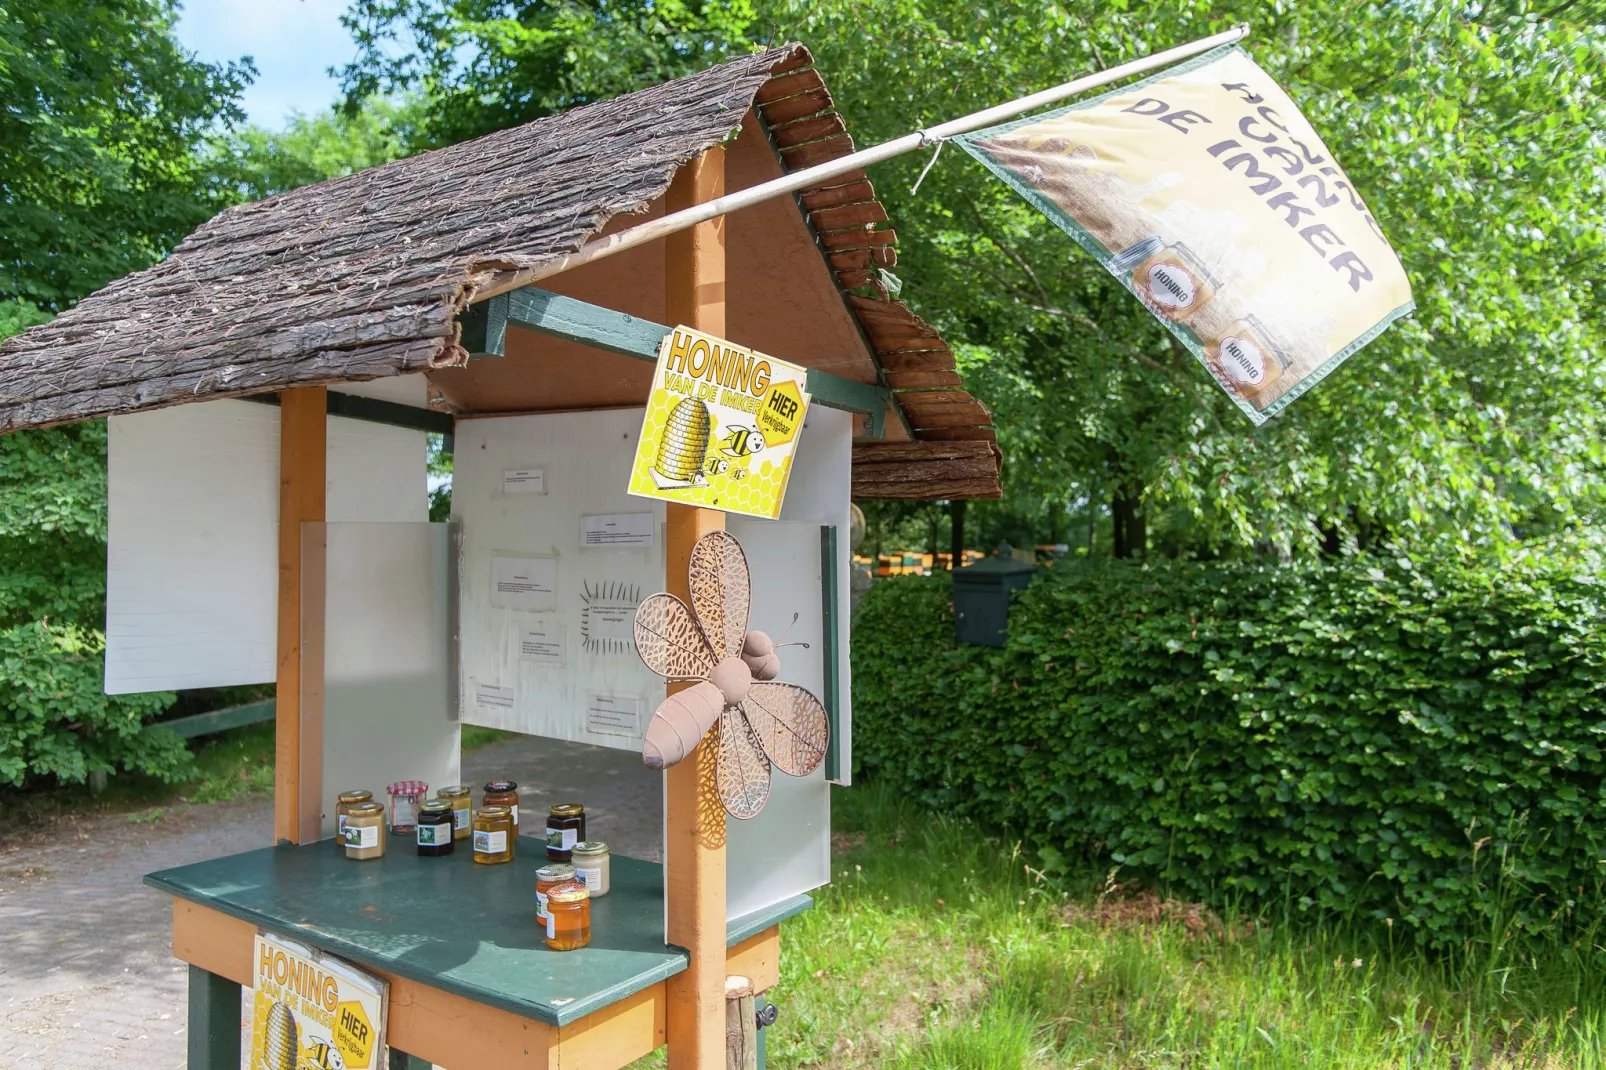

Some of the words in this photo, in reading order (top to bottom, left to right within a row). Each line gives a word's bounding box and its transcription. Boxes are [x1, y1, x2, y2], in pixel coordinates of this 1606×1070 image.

[1120, 97, 1212, 135] DE
[1207, 139, 1374, 293] IMKER
[1154, 268, 1188, 303] HONING
[667, 331, 771, 397] HONING
[1225, 341, 1258, 380] HONING
[664, 373, 694, 395] VAN
[698, 383, 718, 403] DE
[720, 389, 763, 416] IMKER
[769, 389, 798, 421] HIER
[762, 412, 790, 435] Verkrijgbaar
[260, 943, 339, 1012] HONING
[259, 979, 281, 1004] VAN
[284, 992, 298, 1010] DE
[302, 1000, 335, 1030] IMKER
[338, 1030, 364, 1058] Verkrijgbaar
[341, 1008, 368, 1045] HIER
